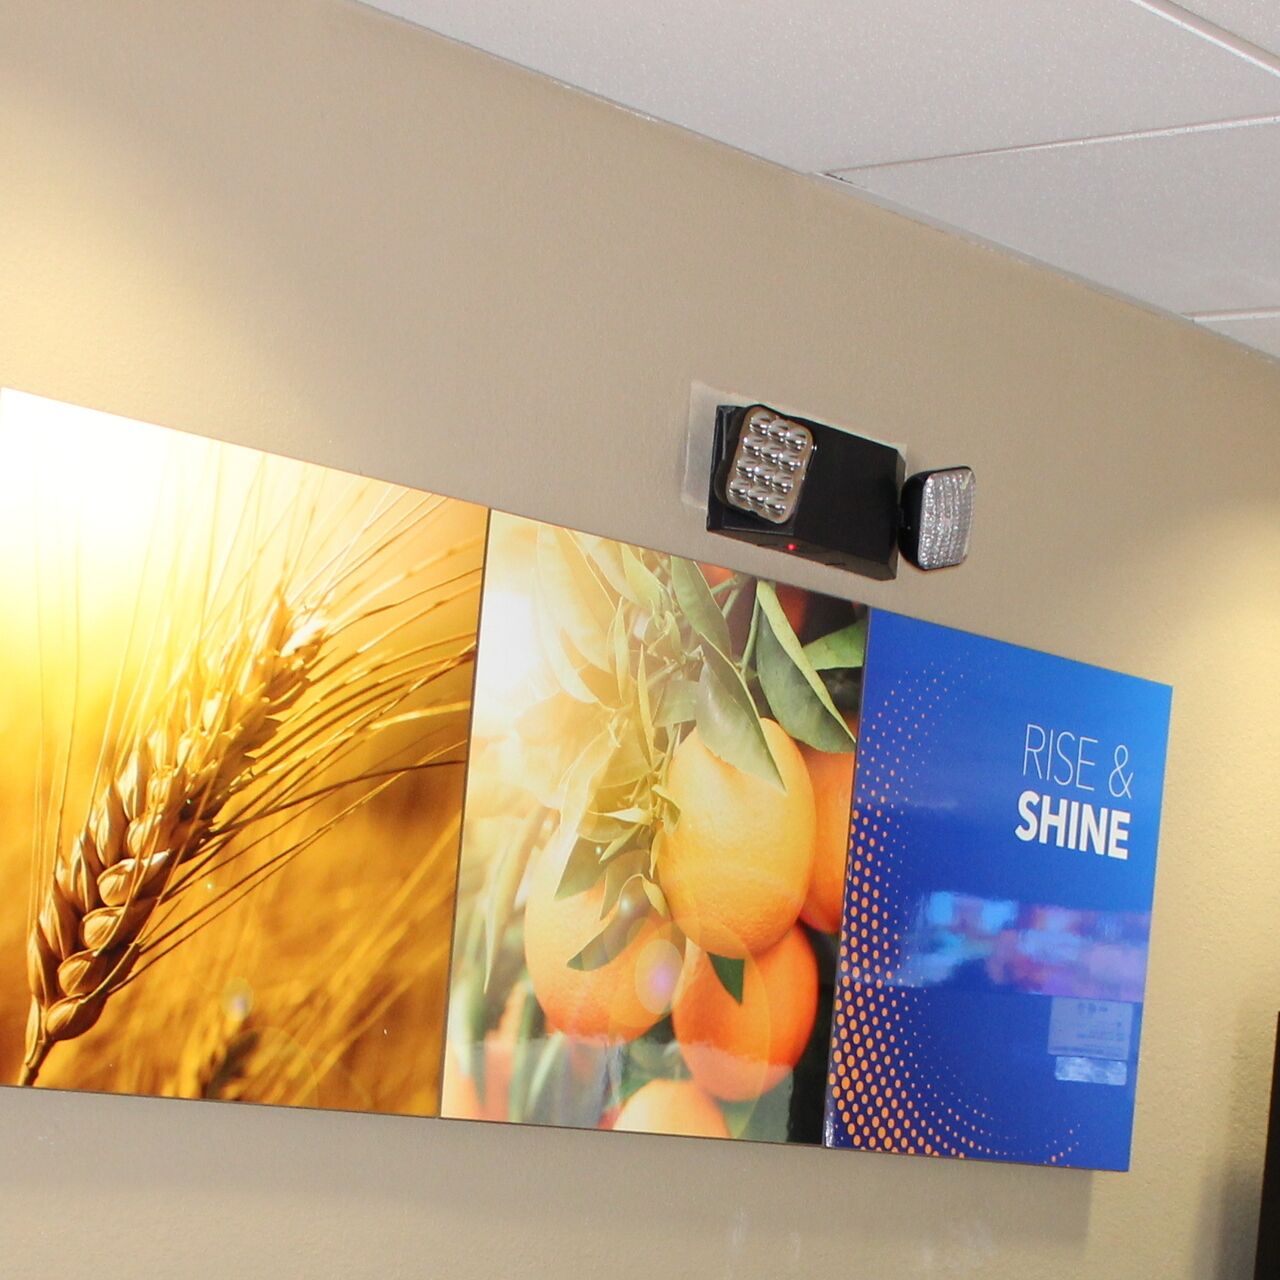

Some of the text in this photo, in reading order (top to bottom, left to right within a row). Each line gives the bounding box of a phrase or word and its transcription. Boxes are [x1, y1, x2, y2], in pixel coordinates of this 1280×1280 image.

[1023, 723, 1134, 800] RISE &
[1014, 790, 1131, 860] SHINE
